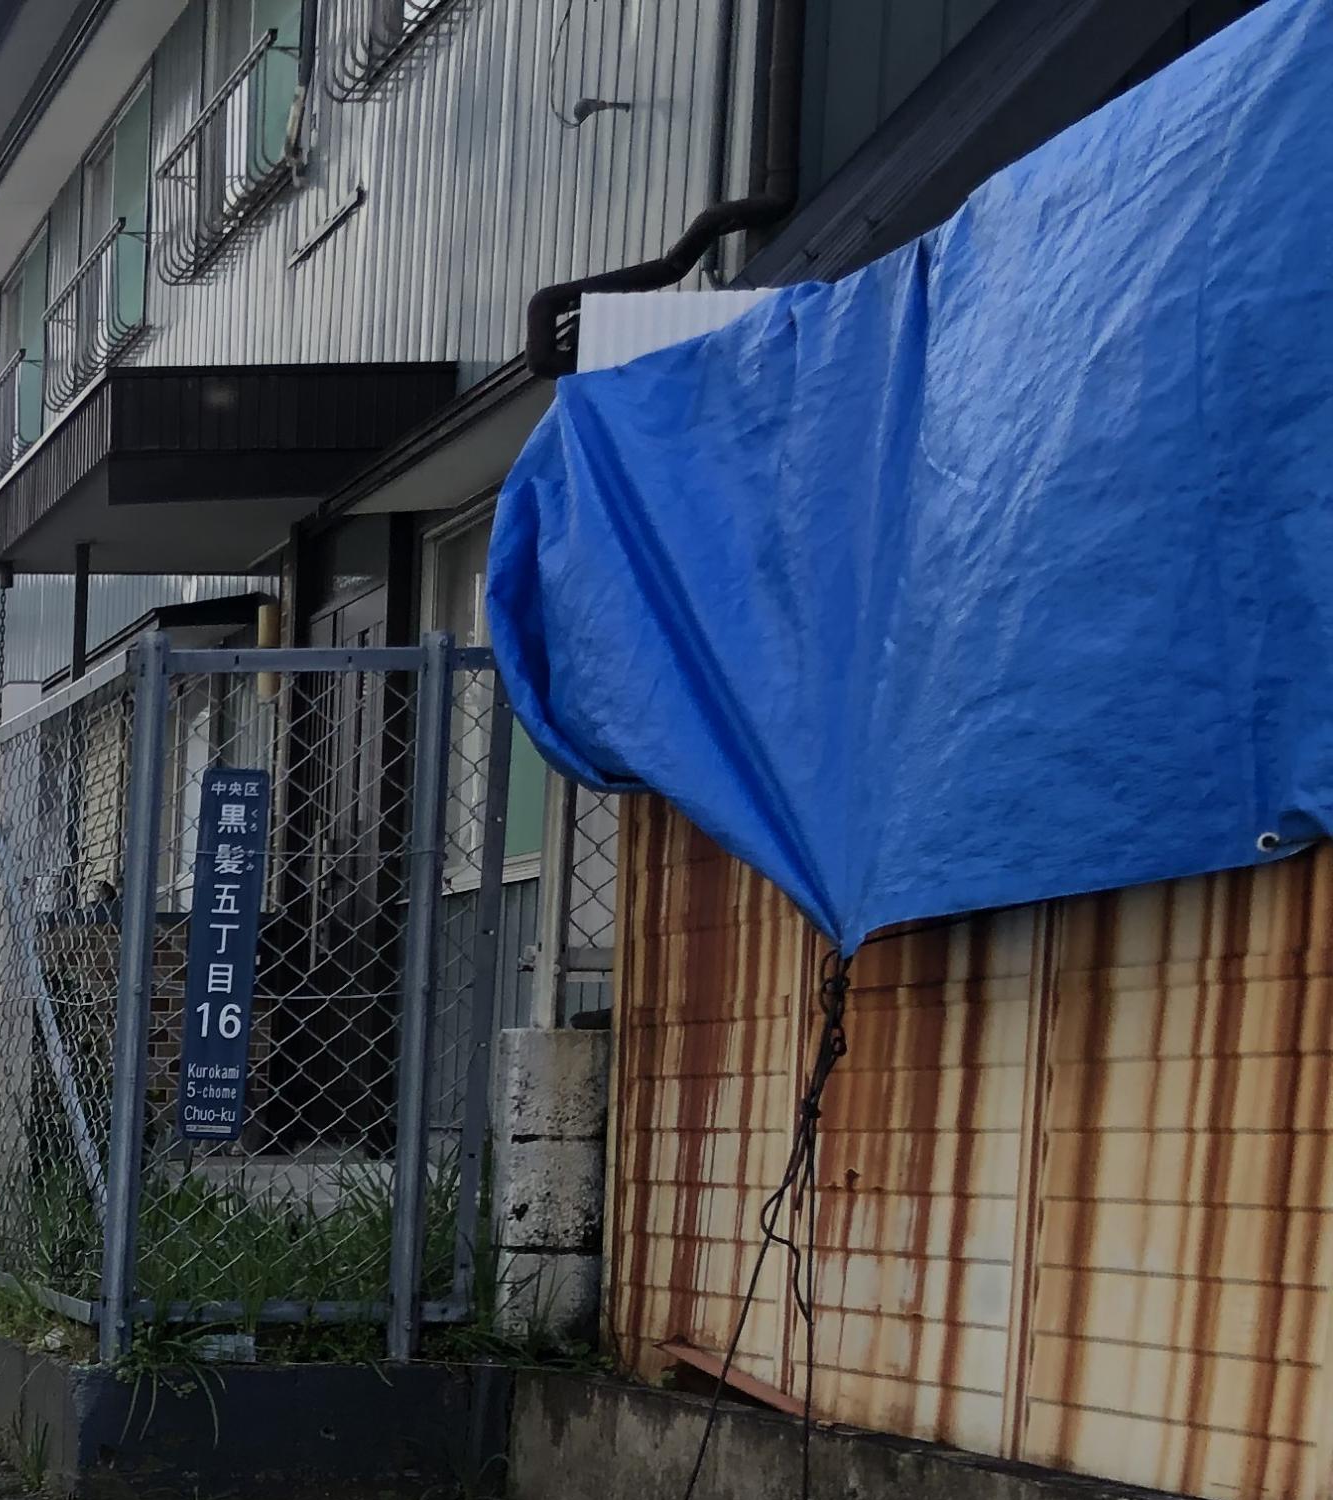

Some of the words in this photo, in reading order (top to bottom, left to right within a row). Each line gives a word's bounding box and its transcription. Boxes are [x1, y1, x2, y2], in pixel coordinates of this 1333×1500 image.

[211, 780, 259, 797] 中央区
[207, 803, 247, 994] 黒髪五丁目
[196, 1002, 242, 1039] 16
[187, 1063, 240, 1079] Kurokami
[186, 1081, 237, 1099] 5-chome
[184, 1105, 236, 1121] Chuo-ku
